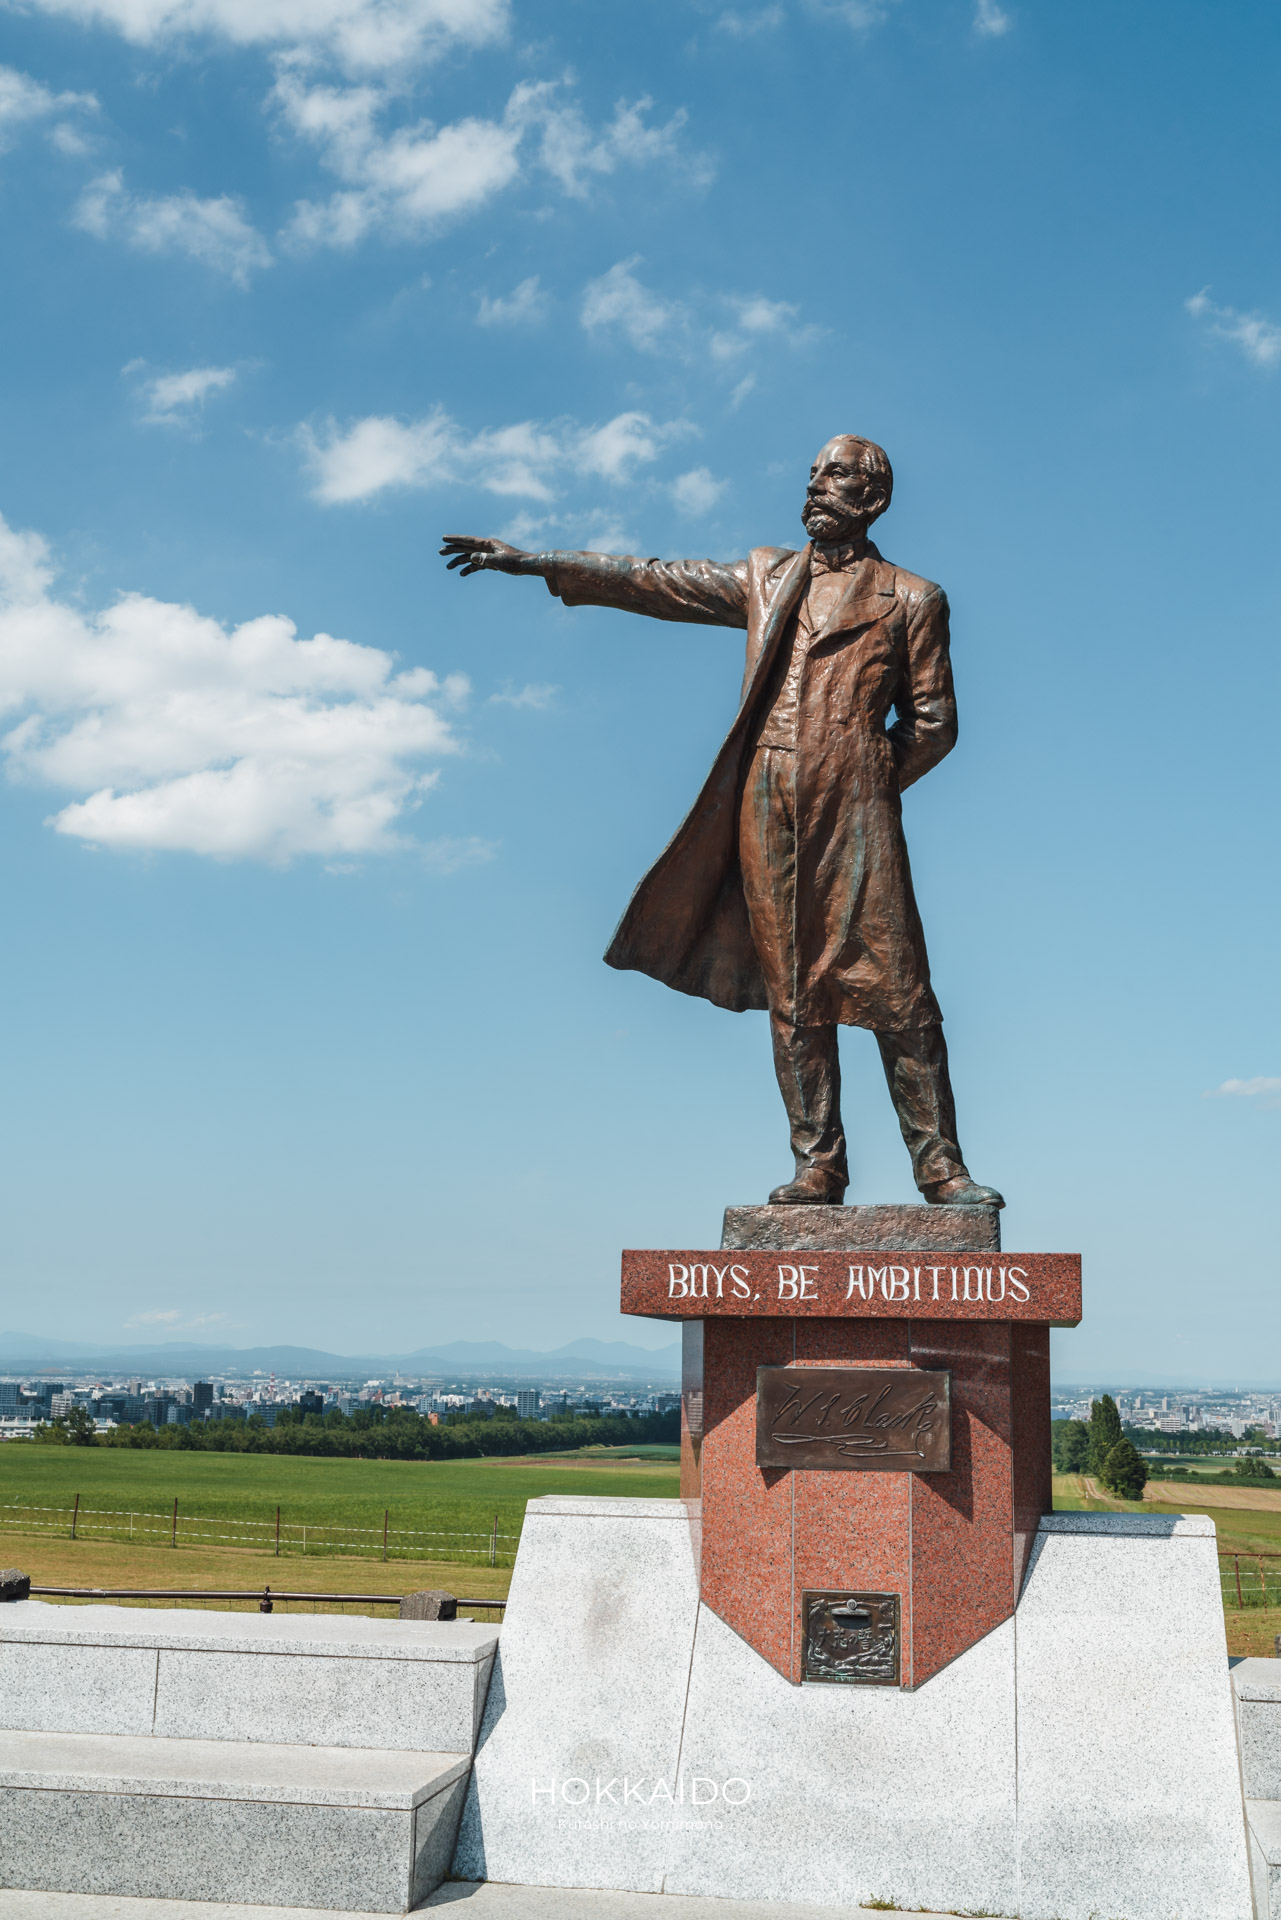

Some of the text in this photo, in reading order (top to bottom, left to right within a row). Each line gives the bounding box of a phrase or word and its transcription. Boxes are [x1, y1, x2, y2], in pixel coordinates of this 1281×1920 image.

[668, 1263, 1031, 1303] BOYS, BE AMBITIOUS
